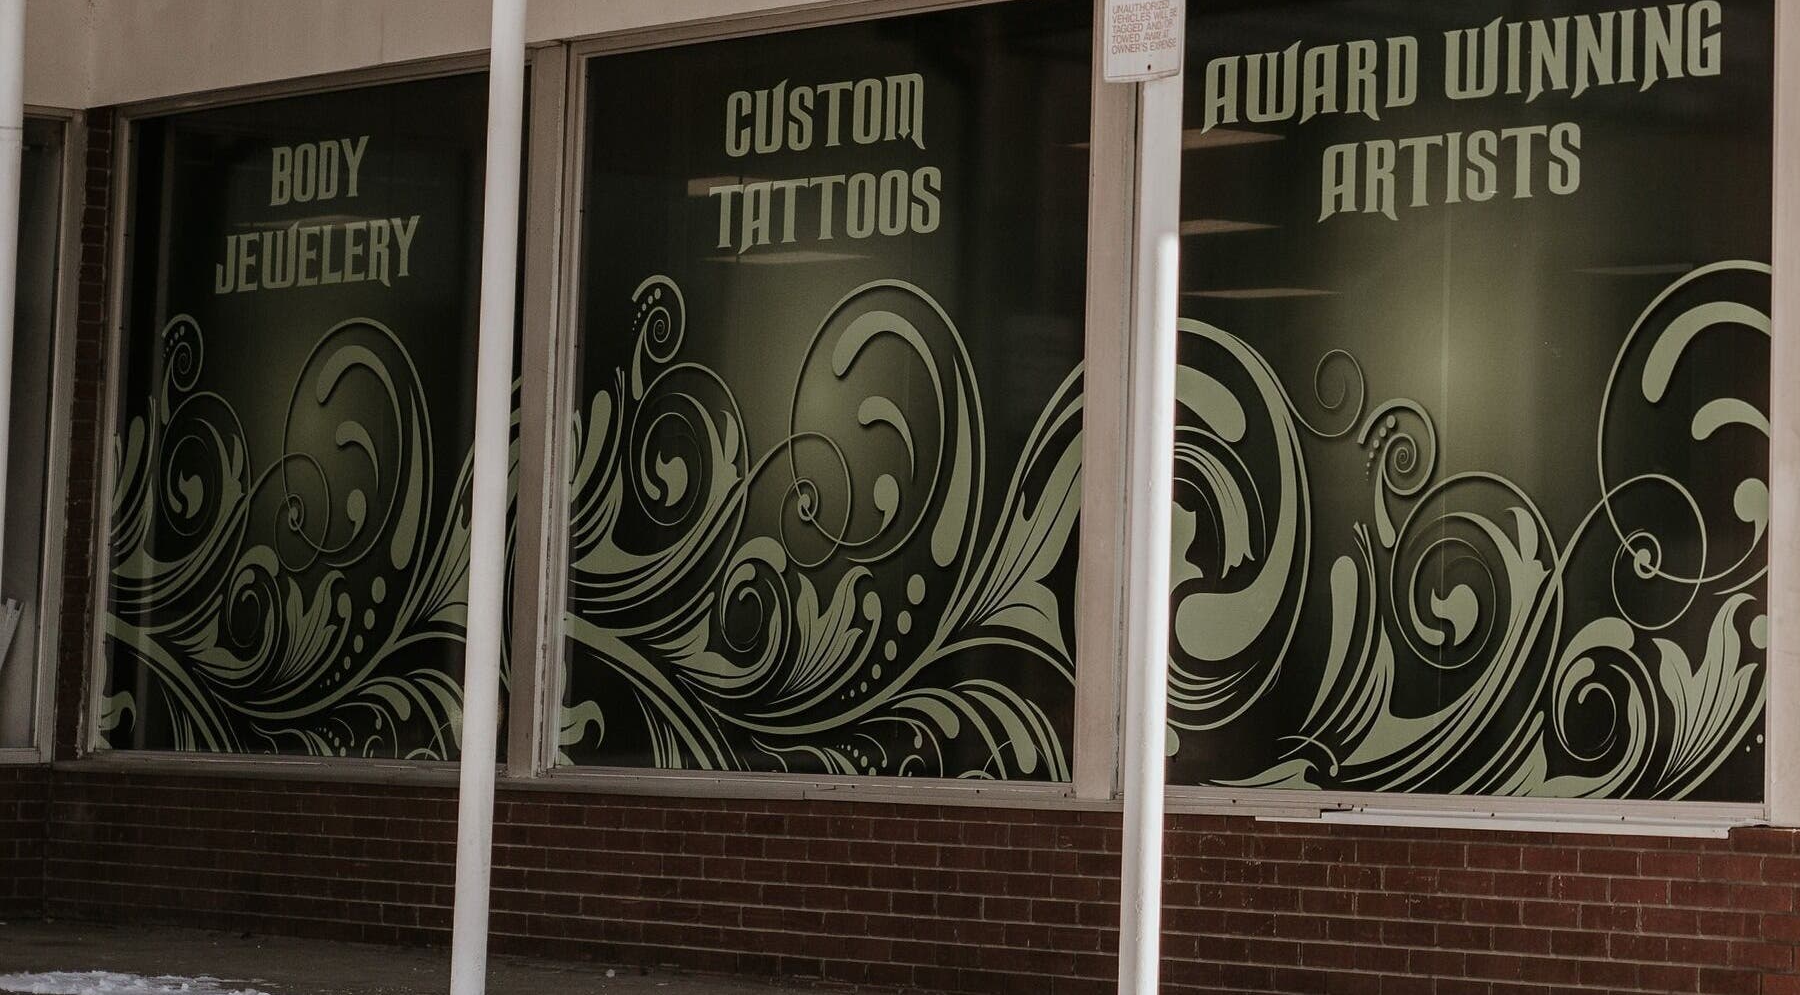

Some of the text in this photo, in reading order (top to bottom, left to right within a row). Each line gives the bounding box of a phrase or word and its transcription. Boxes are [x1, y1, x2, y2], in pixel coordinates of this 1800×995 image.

[1112, 34, 1140, 44] TOWED
[1201, 0, 1722, 135] AWARD WINNING
[725, 73, 926, 157] CUSTOM
[270, 136, 370, 206] BODY
[709, 166, 942, 254] TATTOOS
[1318, 122, 1581, 223] ARTISTS
[215, 215, 420, 294] JEWELERY
